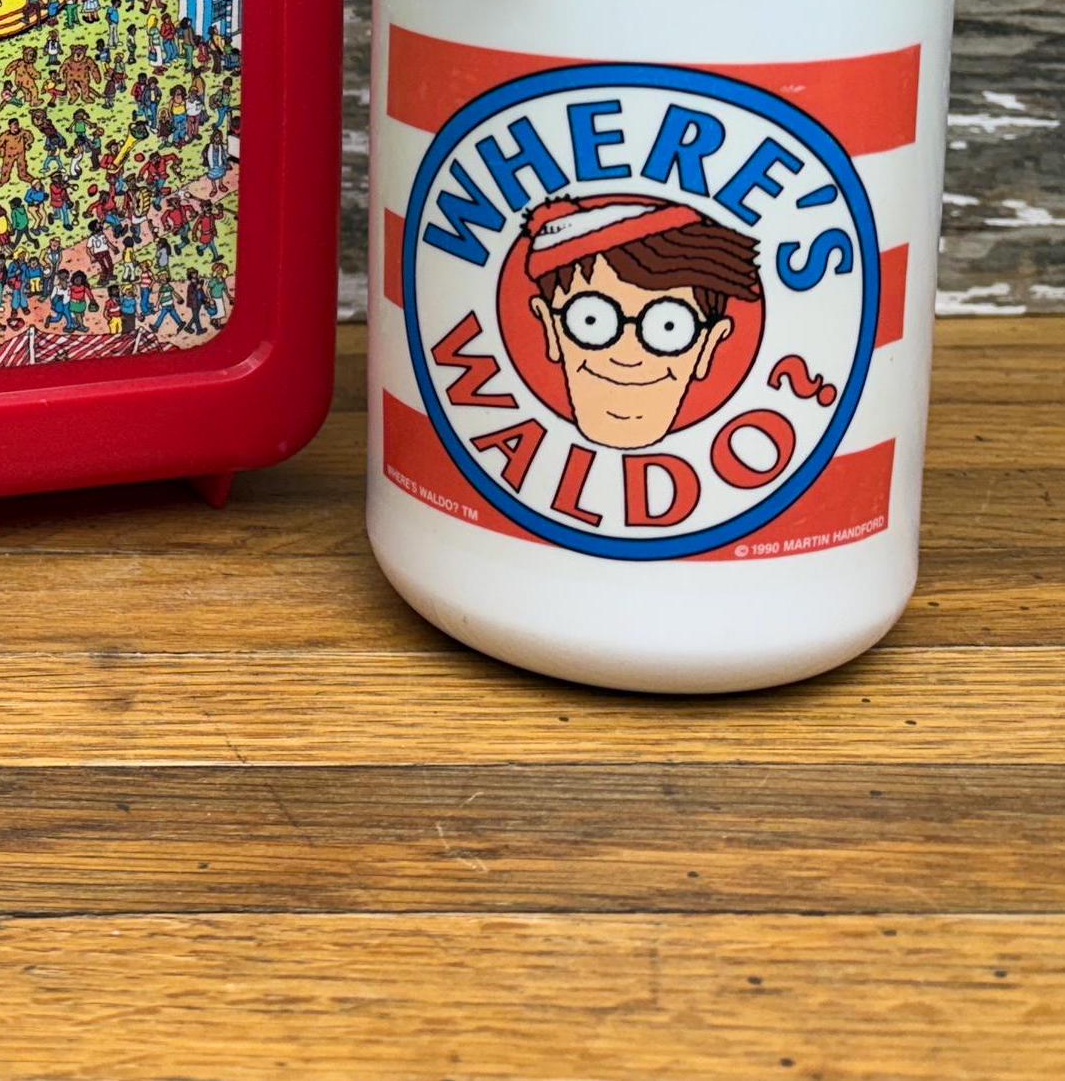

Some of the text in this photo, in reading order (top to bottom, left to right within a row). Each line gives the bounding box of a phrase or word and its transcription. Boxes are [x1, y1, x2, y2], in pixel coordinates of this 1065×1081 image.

[423, 98, 855, 293] WHERE'S
[431, 310, 838, 528] WALDO?
[419, 486, 459, 513] WALDO?
[461, 505, 479, 521] TM
[751, 543, 780, 555] 1990
[783, 533, 830, 552] MARTIN
[832, 516, 884, 543] HANDFORD
